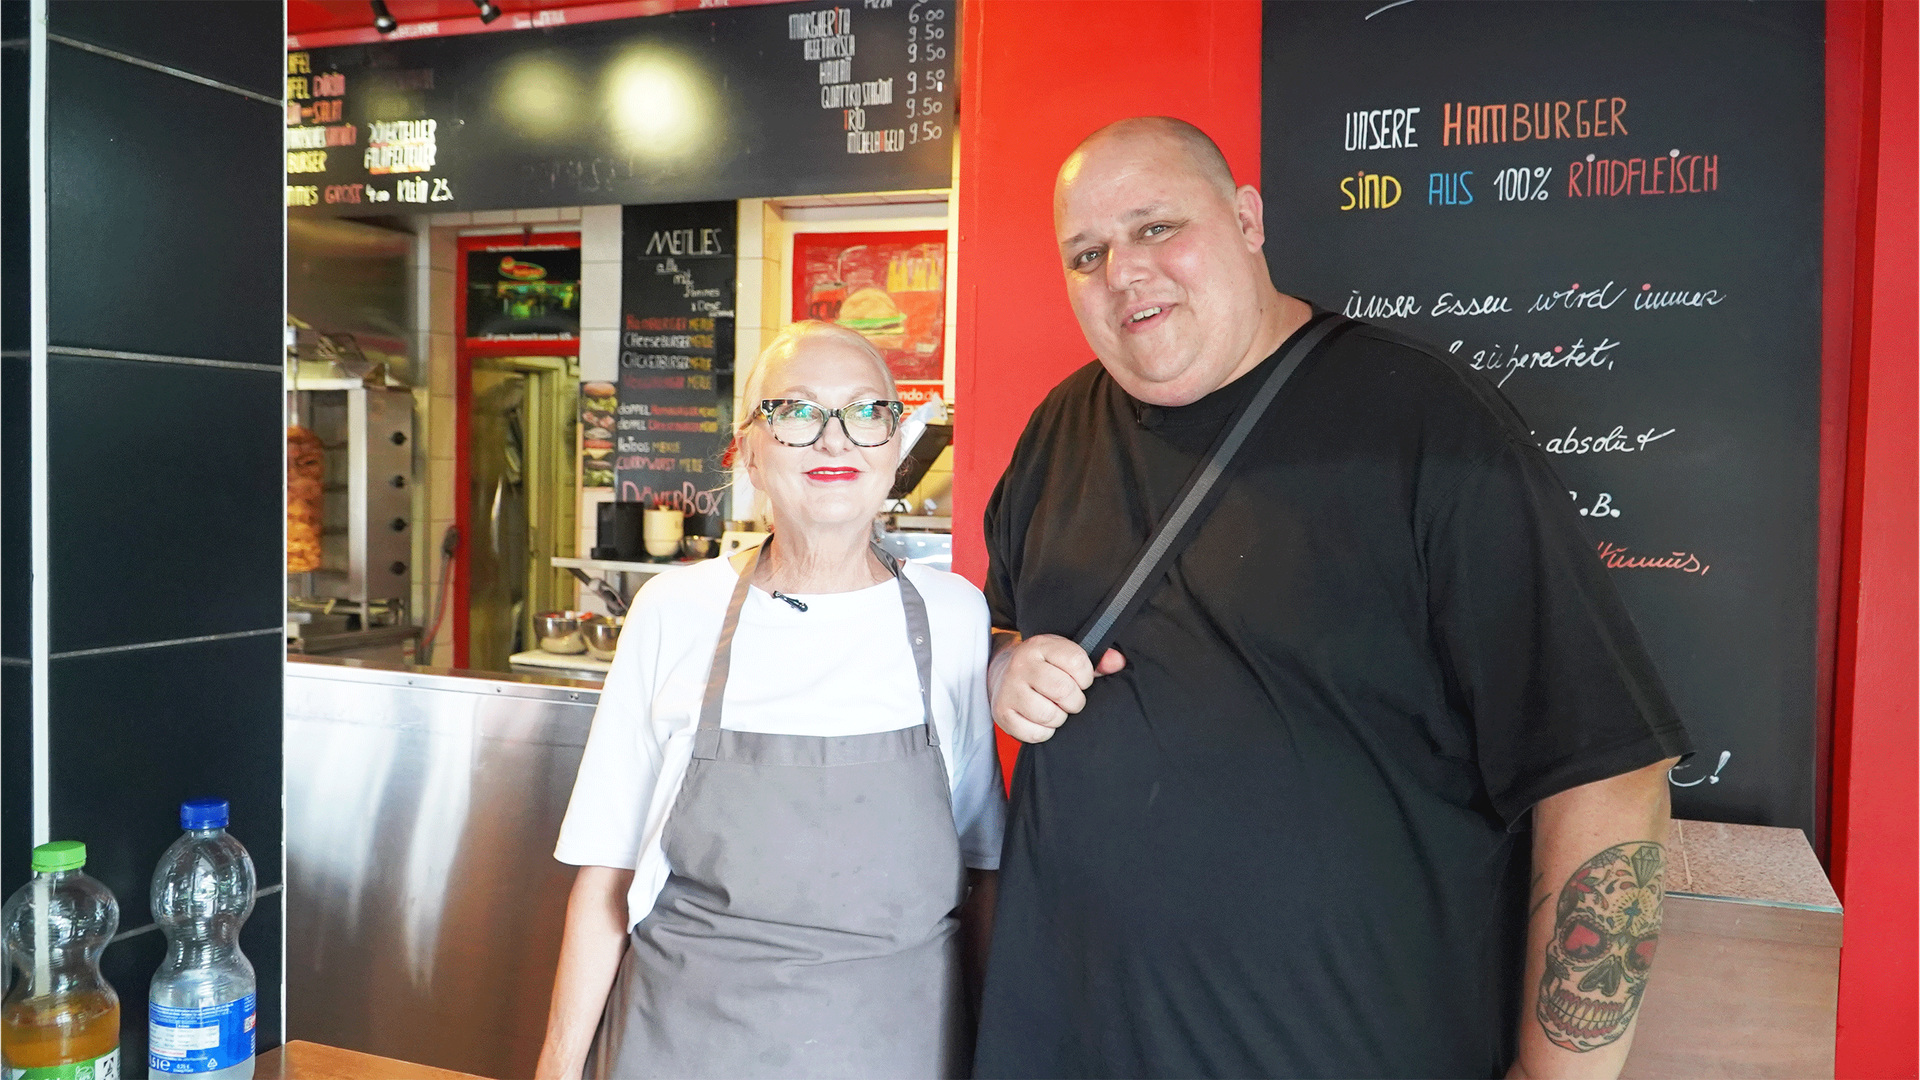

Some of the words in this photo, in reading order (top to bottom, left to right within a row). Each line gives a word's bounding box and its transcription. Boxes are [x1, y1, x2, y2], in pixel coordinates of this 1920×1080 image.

[908, 3, 945, 24] 6.00
[908, 23, 945, 43] 9.50
[907, 43, 946, 63] 9.50
[907, 69, 945, 95] 9.50
[906, 97, 943, 119] 9.50
[908, 120, 943, 145] 9.50
[1345, 107, 1421, 151] UNSERE
[1443, 97, 1629, 147] HAMBURGER
[1428, 170, 1474, 206] AUS
[1493, 166, 1552, 201] 100%
[1430, 292, 1513, 317] Essen
[1527, 280, 1628, 314] wird
[1633, 282, 1727, 311] immer
